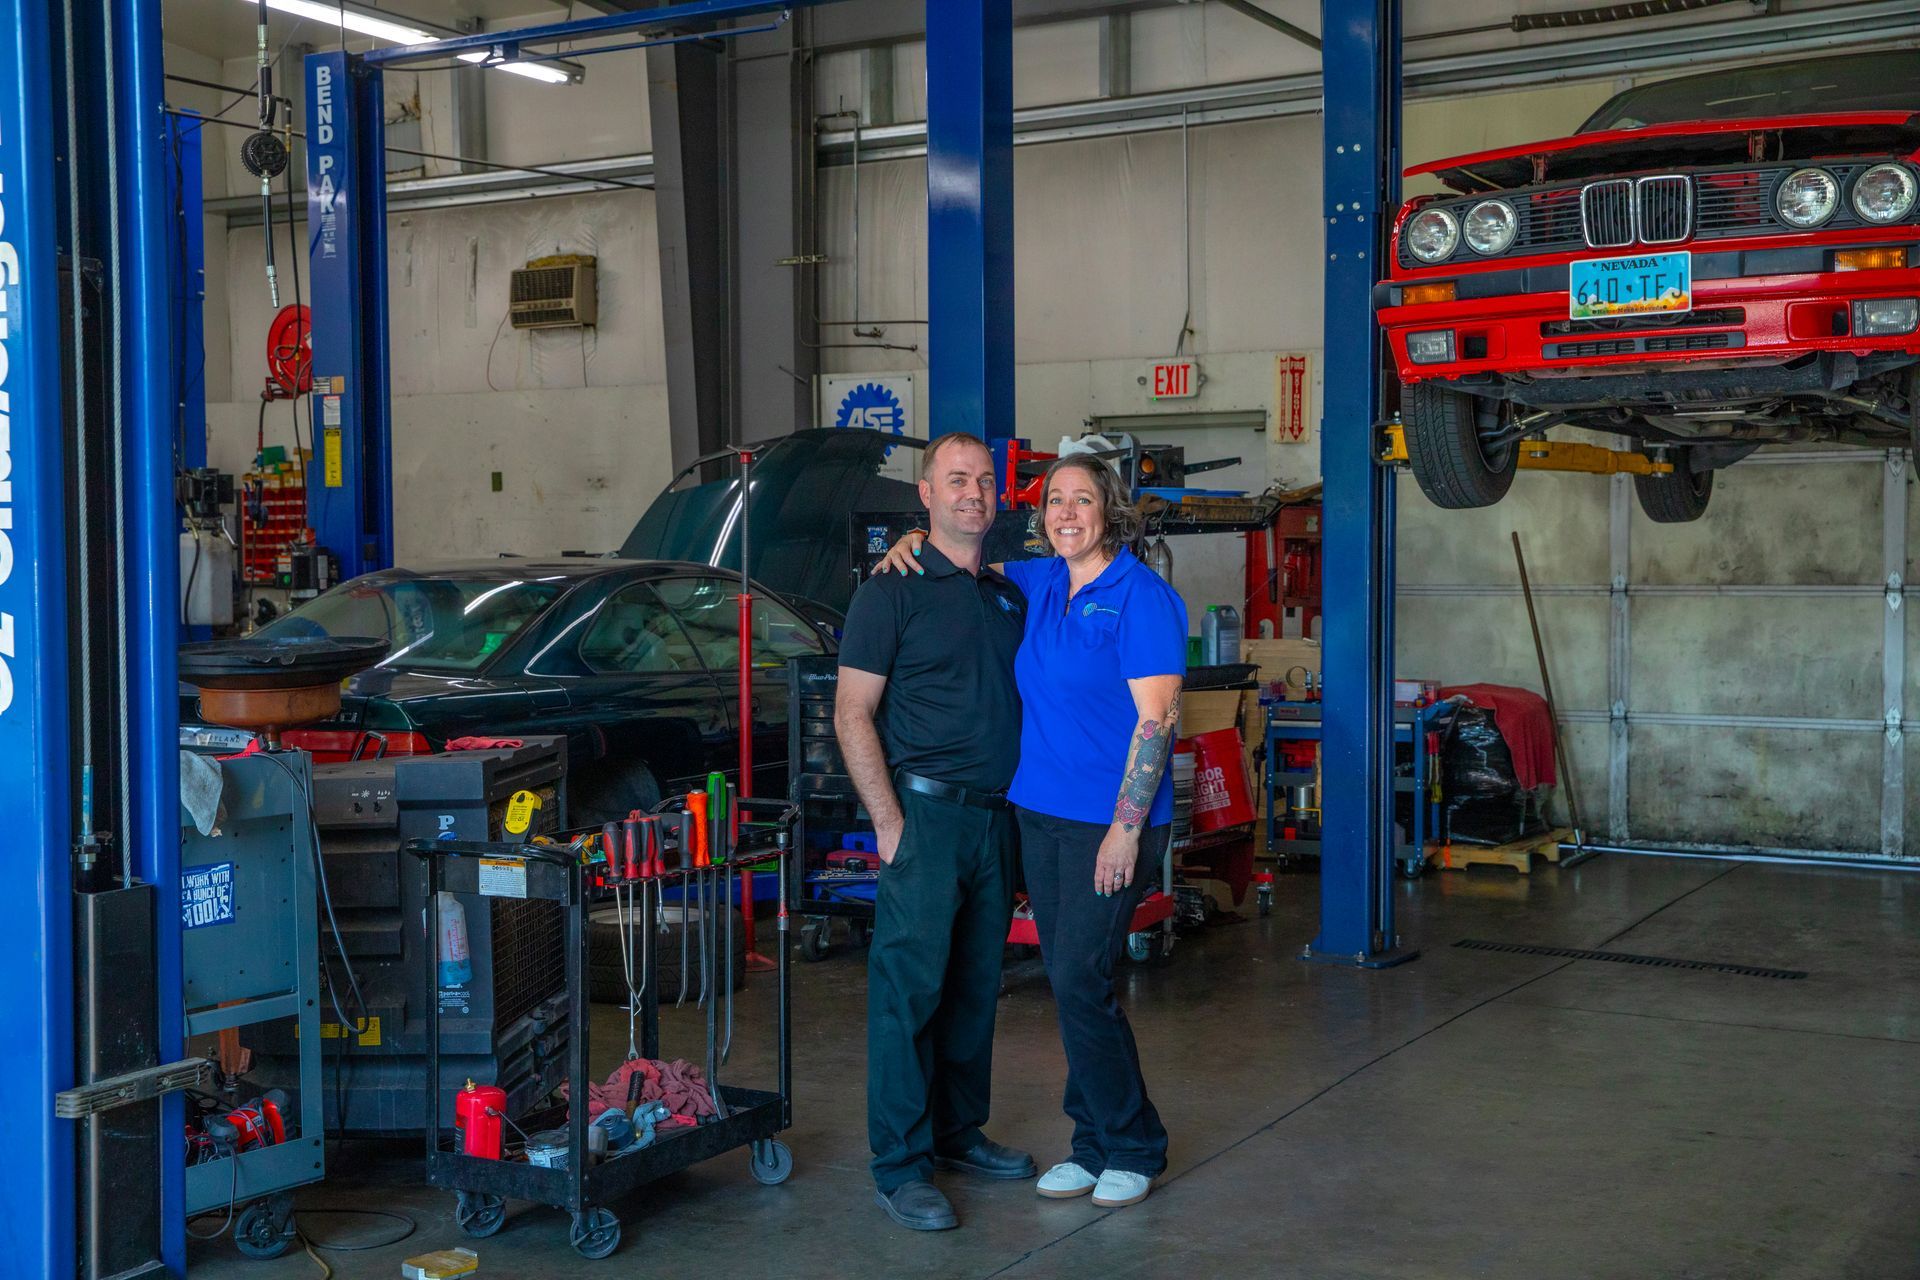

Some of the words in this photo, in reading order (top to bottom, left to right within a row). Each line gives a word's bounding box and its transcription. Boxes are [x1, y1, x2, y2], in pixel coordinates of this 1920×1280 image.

[316, 66, 333, 145] BEND
[319, 155, 335, 214] PAK
[1600, 258, 1658, 272] NEVADA
[1577, 277, 1618, 306] 610
[1640, 272, 1683, 301] TFJ
[1155, 365, 1191, 395] EXIT
[846, 406, 893, 433] ASE
[1196, 767, 1224, 782] BOR
[1197, 778, 1226, 796] IGHT
[186, 873, 209, 889] WORK
[211, 870, 230, 884] WITH
[193, 886, 215, 901] BUNCH
[216, 885, 226, 898] OF
[183, 895, 231, 927] TOOLS
